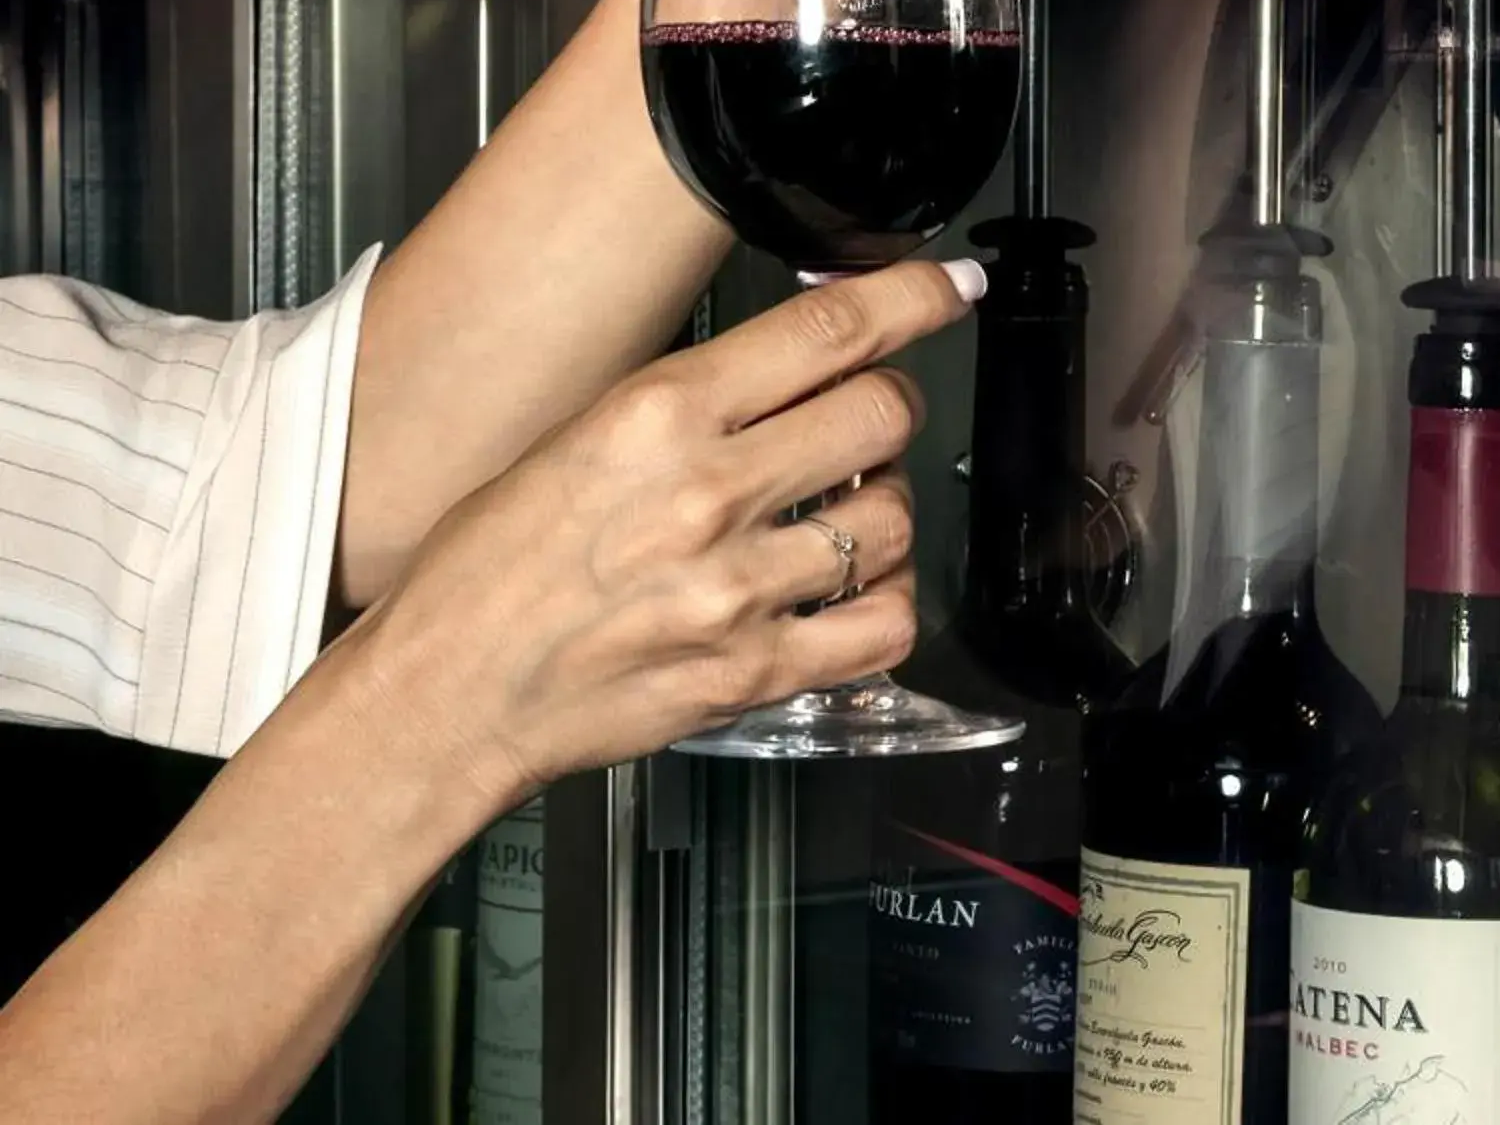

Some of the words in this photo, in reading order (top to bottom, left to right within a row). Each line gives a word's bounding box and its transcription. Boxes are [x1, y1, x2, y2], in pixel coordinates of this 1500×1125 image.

[869, 879, 981, 928] FURLAN
[1313, 956, 1347, 974] 2010
[1011, 1034, 1073, 1055] FURLA
[1296, 1030, 1380, 1061] MALBEC
